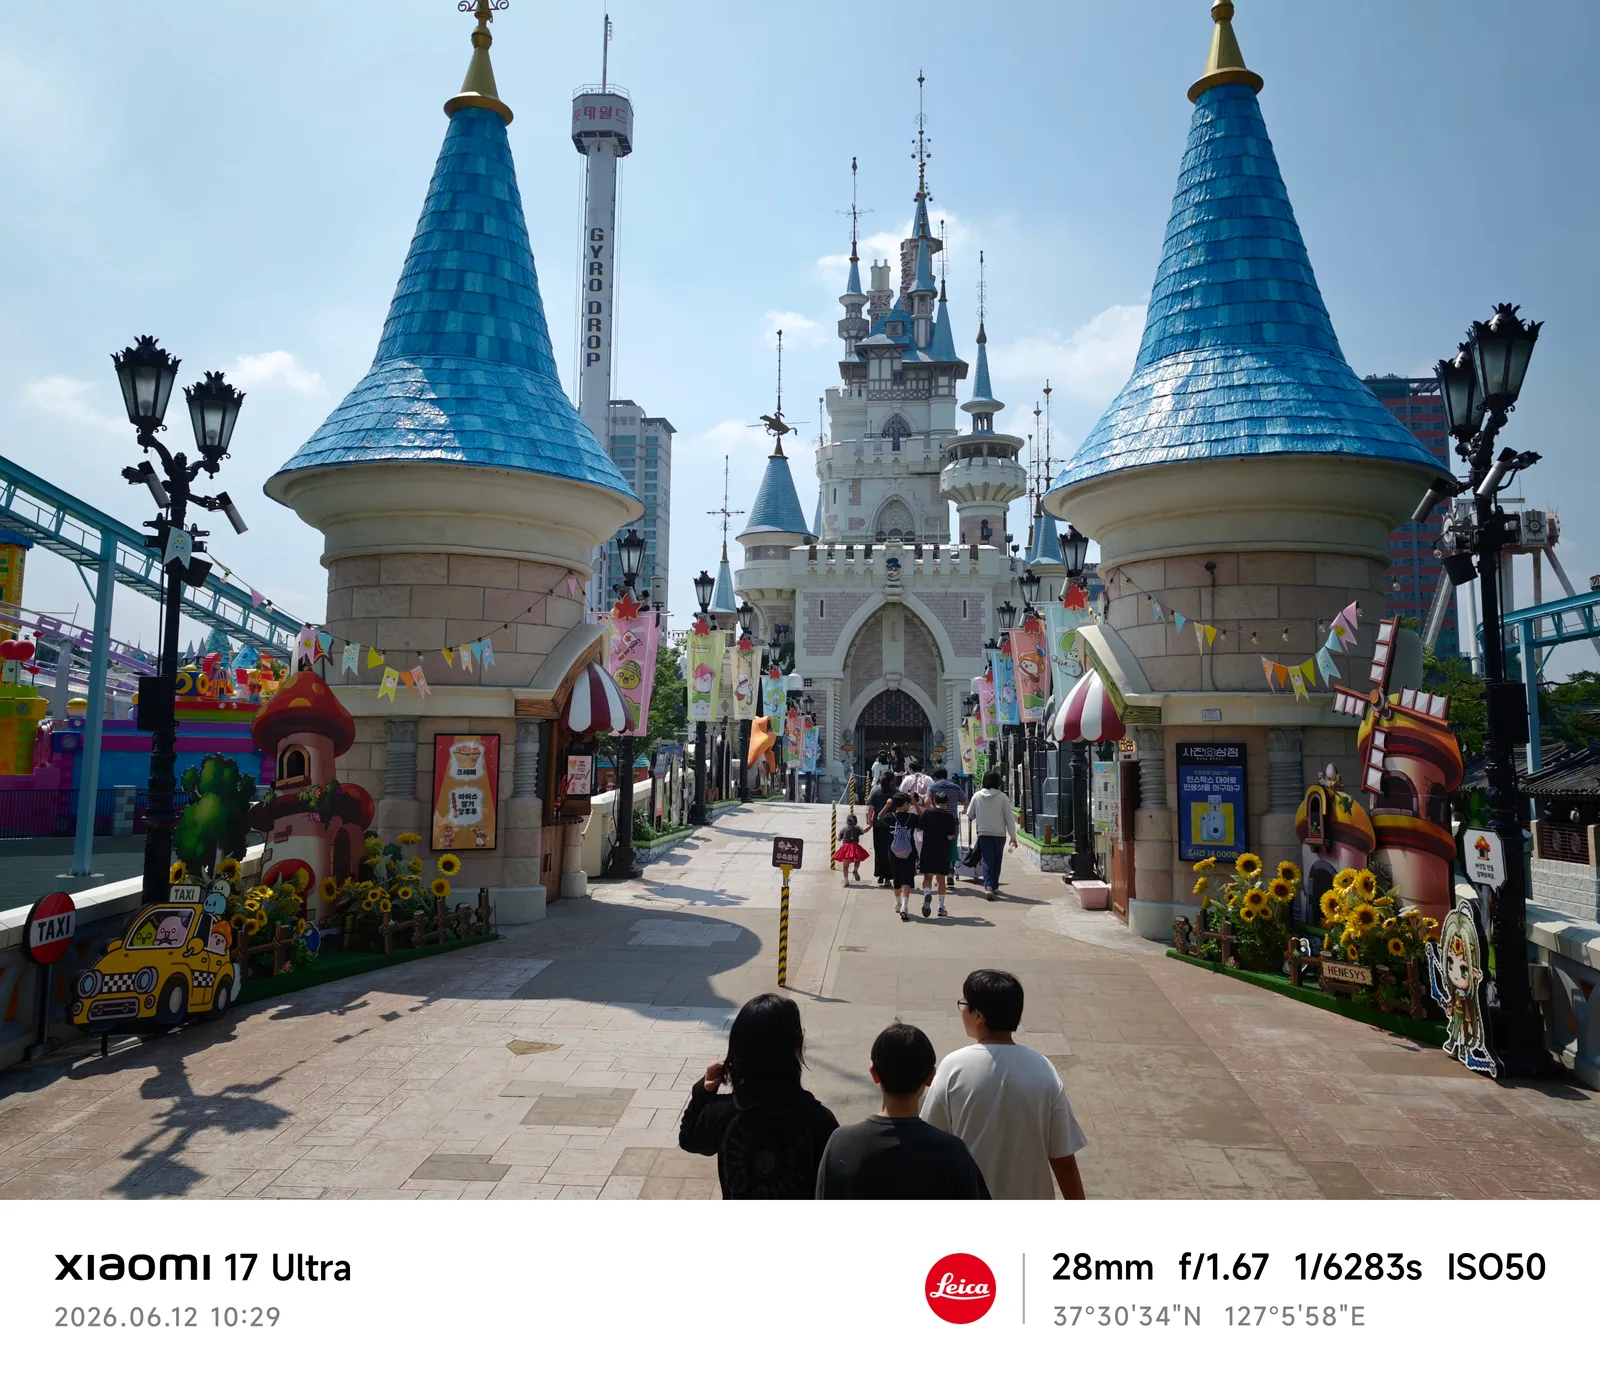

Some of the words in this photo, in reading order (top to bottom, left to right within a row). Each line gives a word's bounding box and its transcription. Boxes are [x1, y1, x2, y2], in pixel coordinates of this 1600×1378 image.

[589, 228, 604, 291] GYRO
[586, 301, 602, 367] DROP
[1186, 776, 1214, 784] 인스탁스
[1212, 784, 1241, 793] 마구마구
[174, 888, 195, 900] TAXI
[38, 915, 70, 941] TAXI
[1328, 966, 1366, 981] HENESYS
